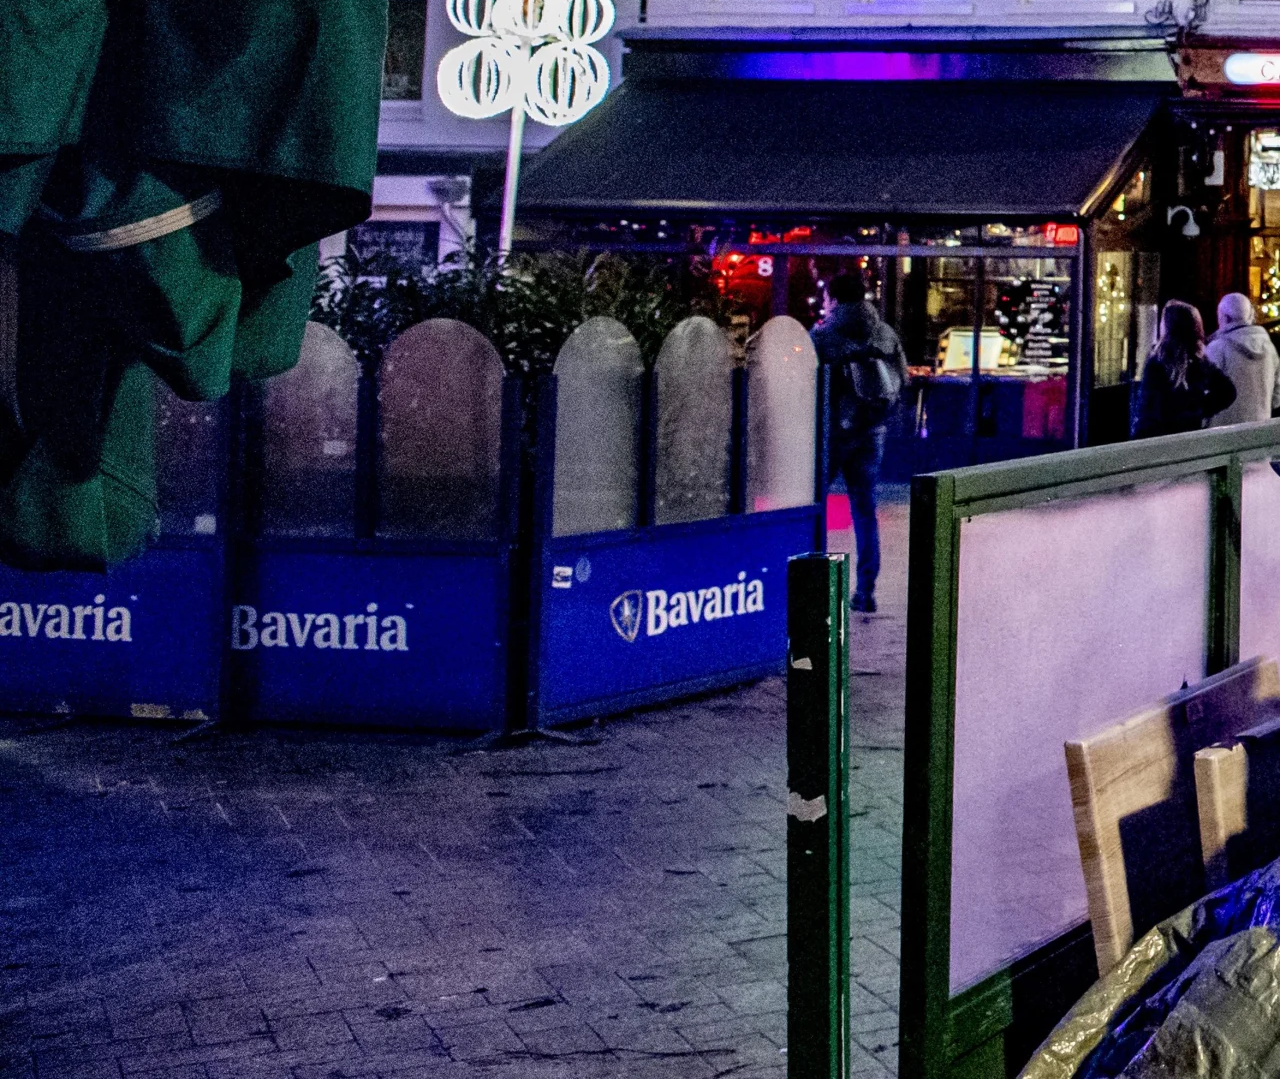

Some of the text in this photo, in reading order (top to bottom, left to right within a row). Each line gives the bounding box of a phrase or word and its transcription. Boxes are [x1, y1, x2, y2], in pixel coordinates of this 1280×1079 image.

[757, 256, 774, 277] 8
[0, 594, 132, 642] avaria
[231, 602, 409, 651] Bavaria
[646, 571, 765, 637] Bavaria
